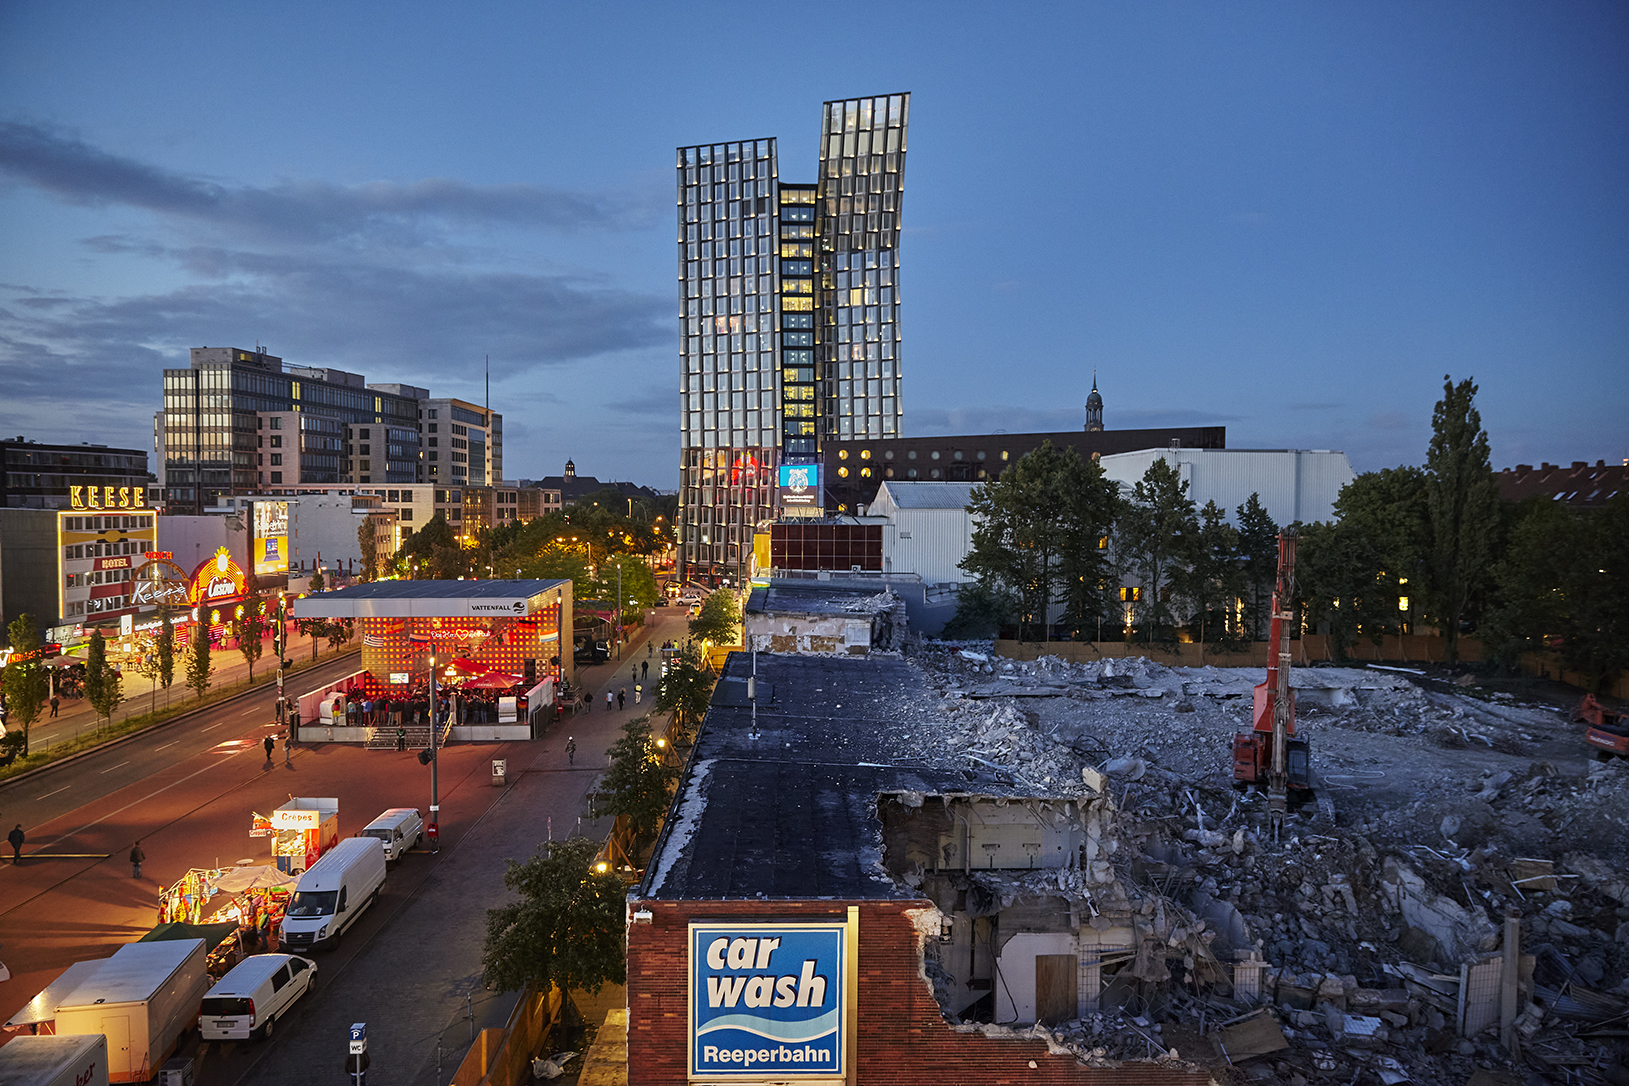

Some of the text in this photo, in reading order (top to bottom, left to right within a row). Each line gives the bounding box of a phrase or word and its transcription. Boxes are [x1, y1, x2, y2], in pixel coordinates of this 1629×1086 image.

[69, 485, 145, 508] KEESE
[101, 558, 128, 569] HOTEL
[144, 551, 174, 560] GOSCH
[208, 576, 236, 598] Casino
[706, 936, 783, 970] car
[707, 959, 828, 1008] wash
[352, 1031, 360, 1040] P
[703, 1045, 831, 1067] Reeperbahn
